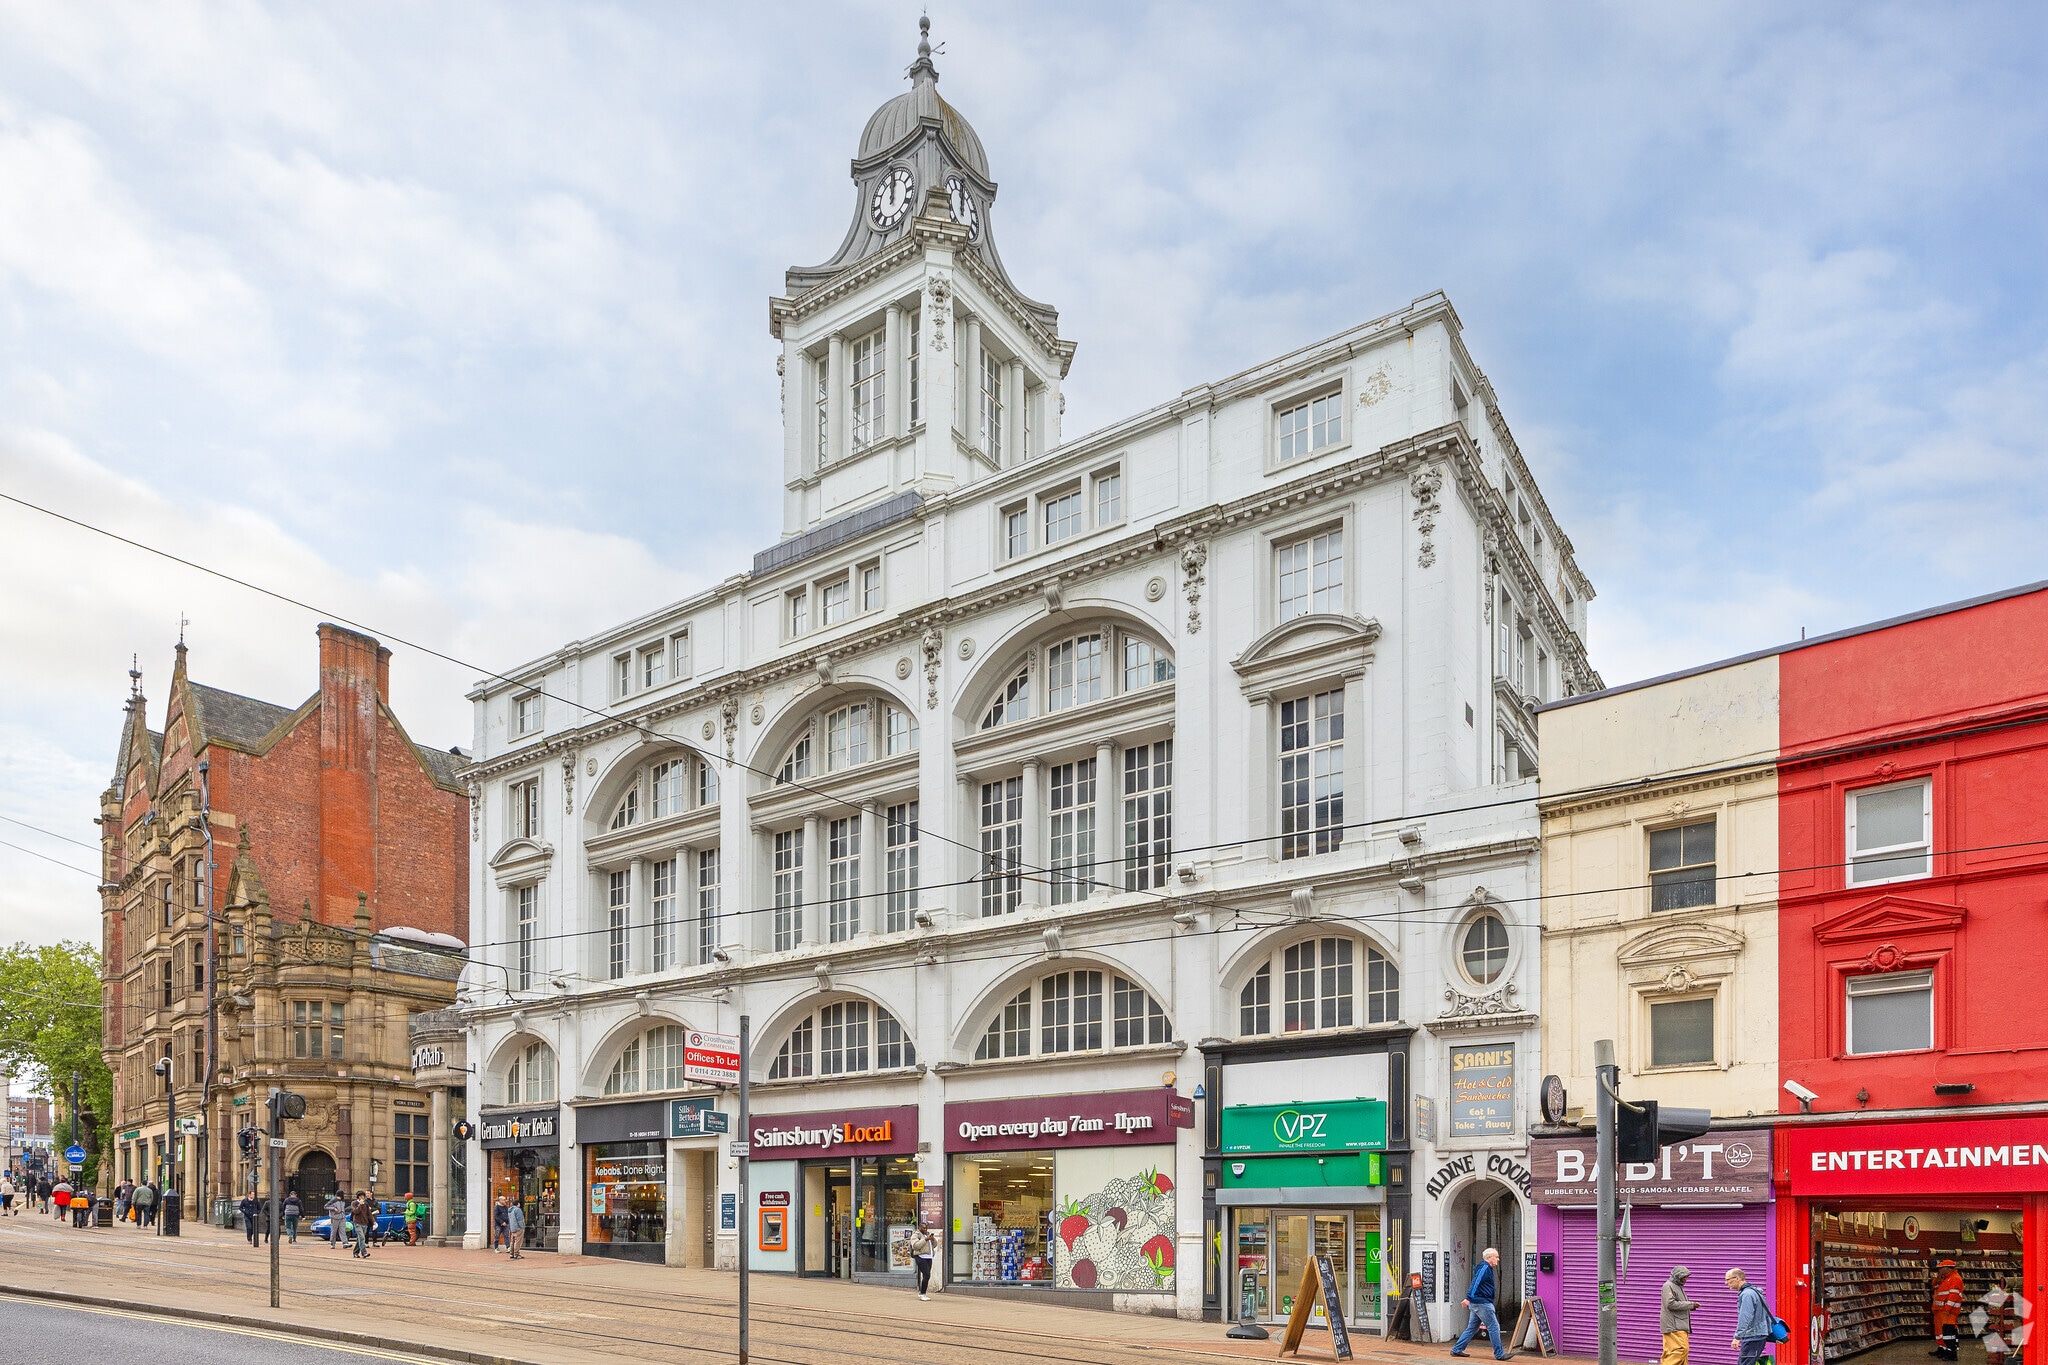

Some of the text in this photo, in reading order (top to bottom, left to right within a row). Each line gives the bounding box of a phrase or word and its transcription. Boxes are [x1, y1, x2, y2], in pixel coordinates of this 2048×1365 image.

[703, 1035, 736, 1045] Crosthwaite
[418, 1047, 441, 1067] Kebab
[687, 1051, 739, 1067] Offices To Let
[1453, 1050, 1512, 1072] SARNI'S
[695, 1067, 709, 1075] 0114
[1454, 1078, 1477, 1090] Hot
[1486, 1076, 1512, 1089] Cold
[1454, 1091, 1511, 1104] Sandwiches
[678, 1105, 690, 1113] Sills
[1171, 1102, 1191, 1114] Sainsbury's
[1469, 1107, 1496, 1116] Eat In
[679, 1112, 700, 1122] Betterid
[481, 1121, 506, 1140] German
[532, 1117, 553, 1136] Kebab
[959, 1121, 998, 1142] Open
[999, 1120, 1038, 1140] every
[1040, 1117, 1068, 1137] day
[1069, 1115, 1104, 1132] 7am
[1114, 1112, 1153, 1135] 11pm
[1281, 1113, 1328, 1138] VPZ
[1455, 1121, 1475, 1130] Take
[1485, 1120, 1511, 1130] Away
[753, 1120, 892, 1148] Sainsbury's Local
[1345, 1140, 1382, 1148] www.vpz.co.uk
[1728, 1147, 1751, 1159] حلال
[1811, 1144, 2048, 1172] ENTERTAINMEN
[1556, 1143, 1724, 1183] BBI'T
[595, 1164, 666, 1176] Kebabs. Done Right.
[1426, 1154, 1476, 1201] ALDINE
[1361, 1294, 1381, 1303] VUS
